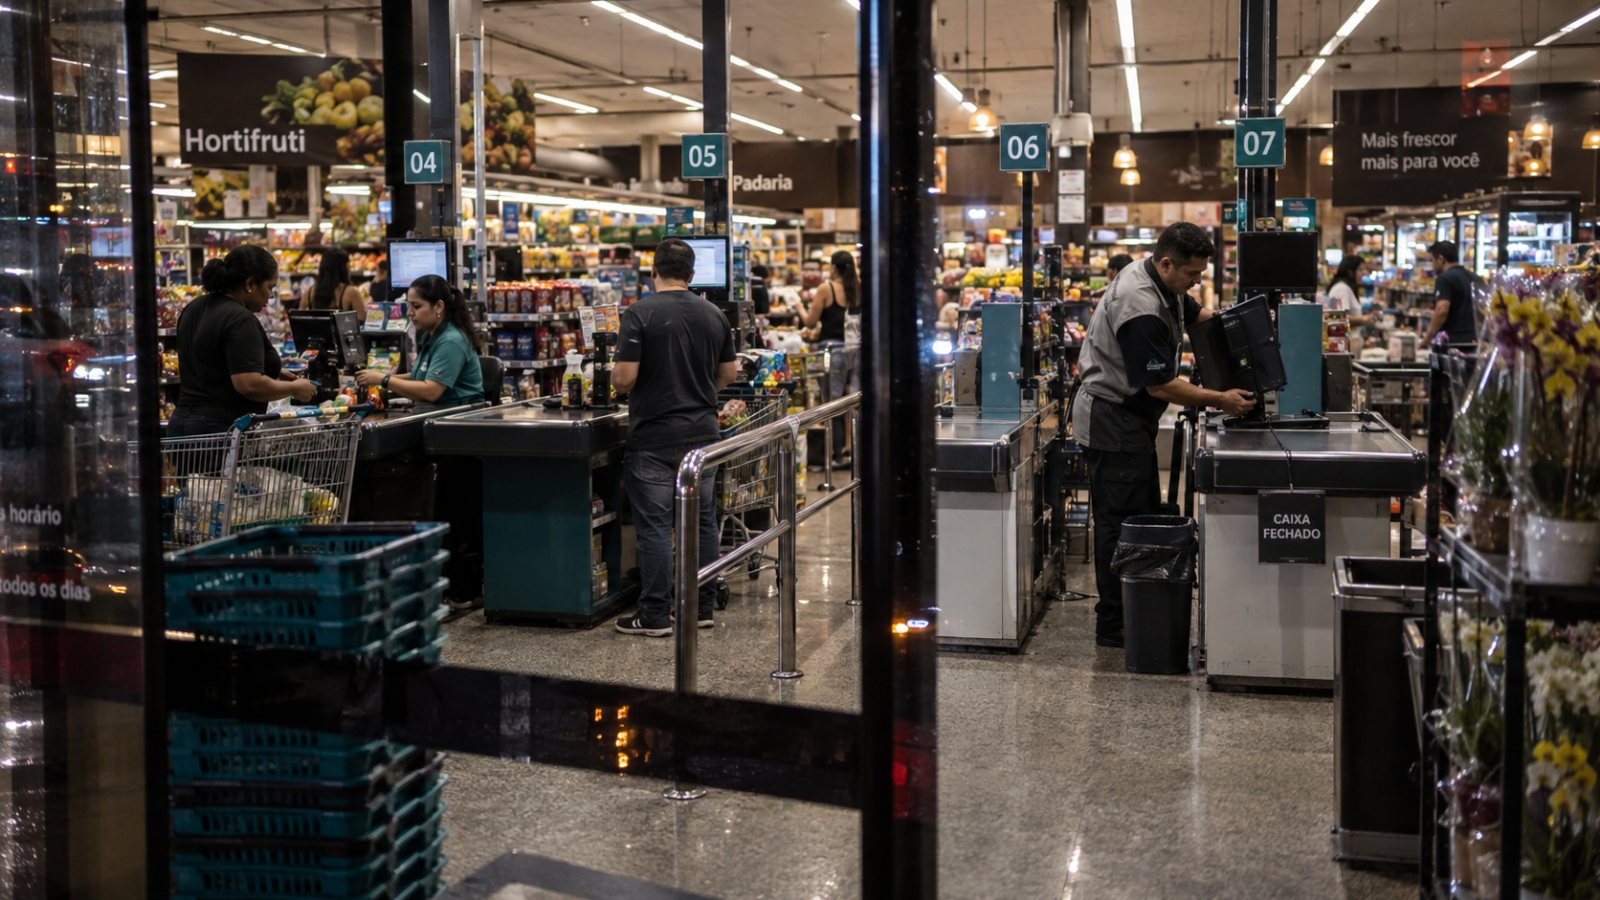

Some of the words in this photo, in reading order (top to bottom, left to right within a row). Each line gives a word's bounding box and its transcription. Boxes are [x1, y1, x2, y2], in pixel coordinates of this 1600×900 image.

[185, 128, 306, 153] Hortifruti
[1007, 135, 1040, 160] 06
[1243, 130, 1277, 156] 07
[1361, 132, 1399, 148] Mais
[1402, 132, 1458, 147] frescor
[410, 151, 437, 174] 04
[688, 144, 717, 168] 05
[1361, 154, 1399, 170] mais
[1403, 156, 1438, 173] para
[1441, 152, 1480, 168] você
[733, 173, 793, 192] Padaria
[9, 503, 62, 526] horário
[1273, 513, 1311, 525] CAIXA
[1263, 528, 1321, 540] FECHADO
[39, 582, 57, 598] os
[60, 578, 92, 602] dias
